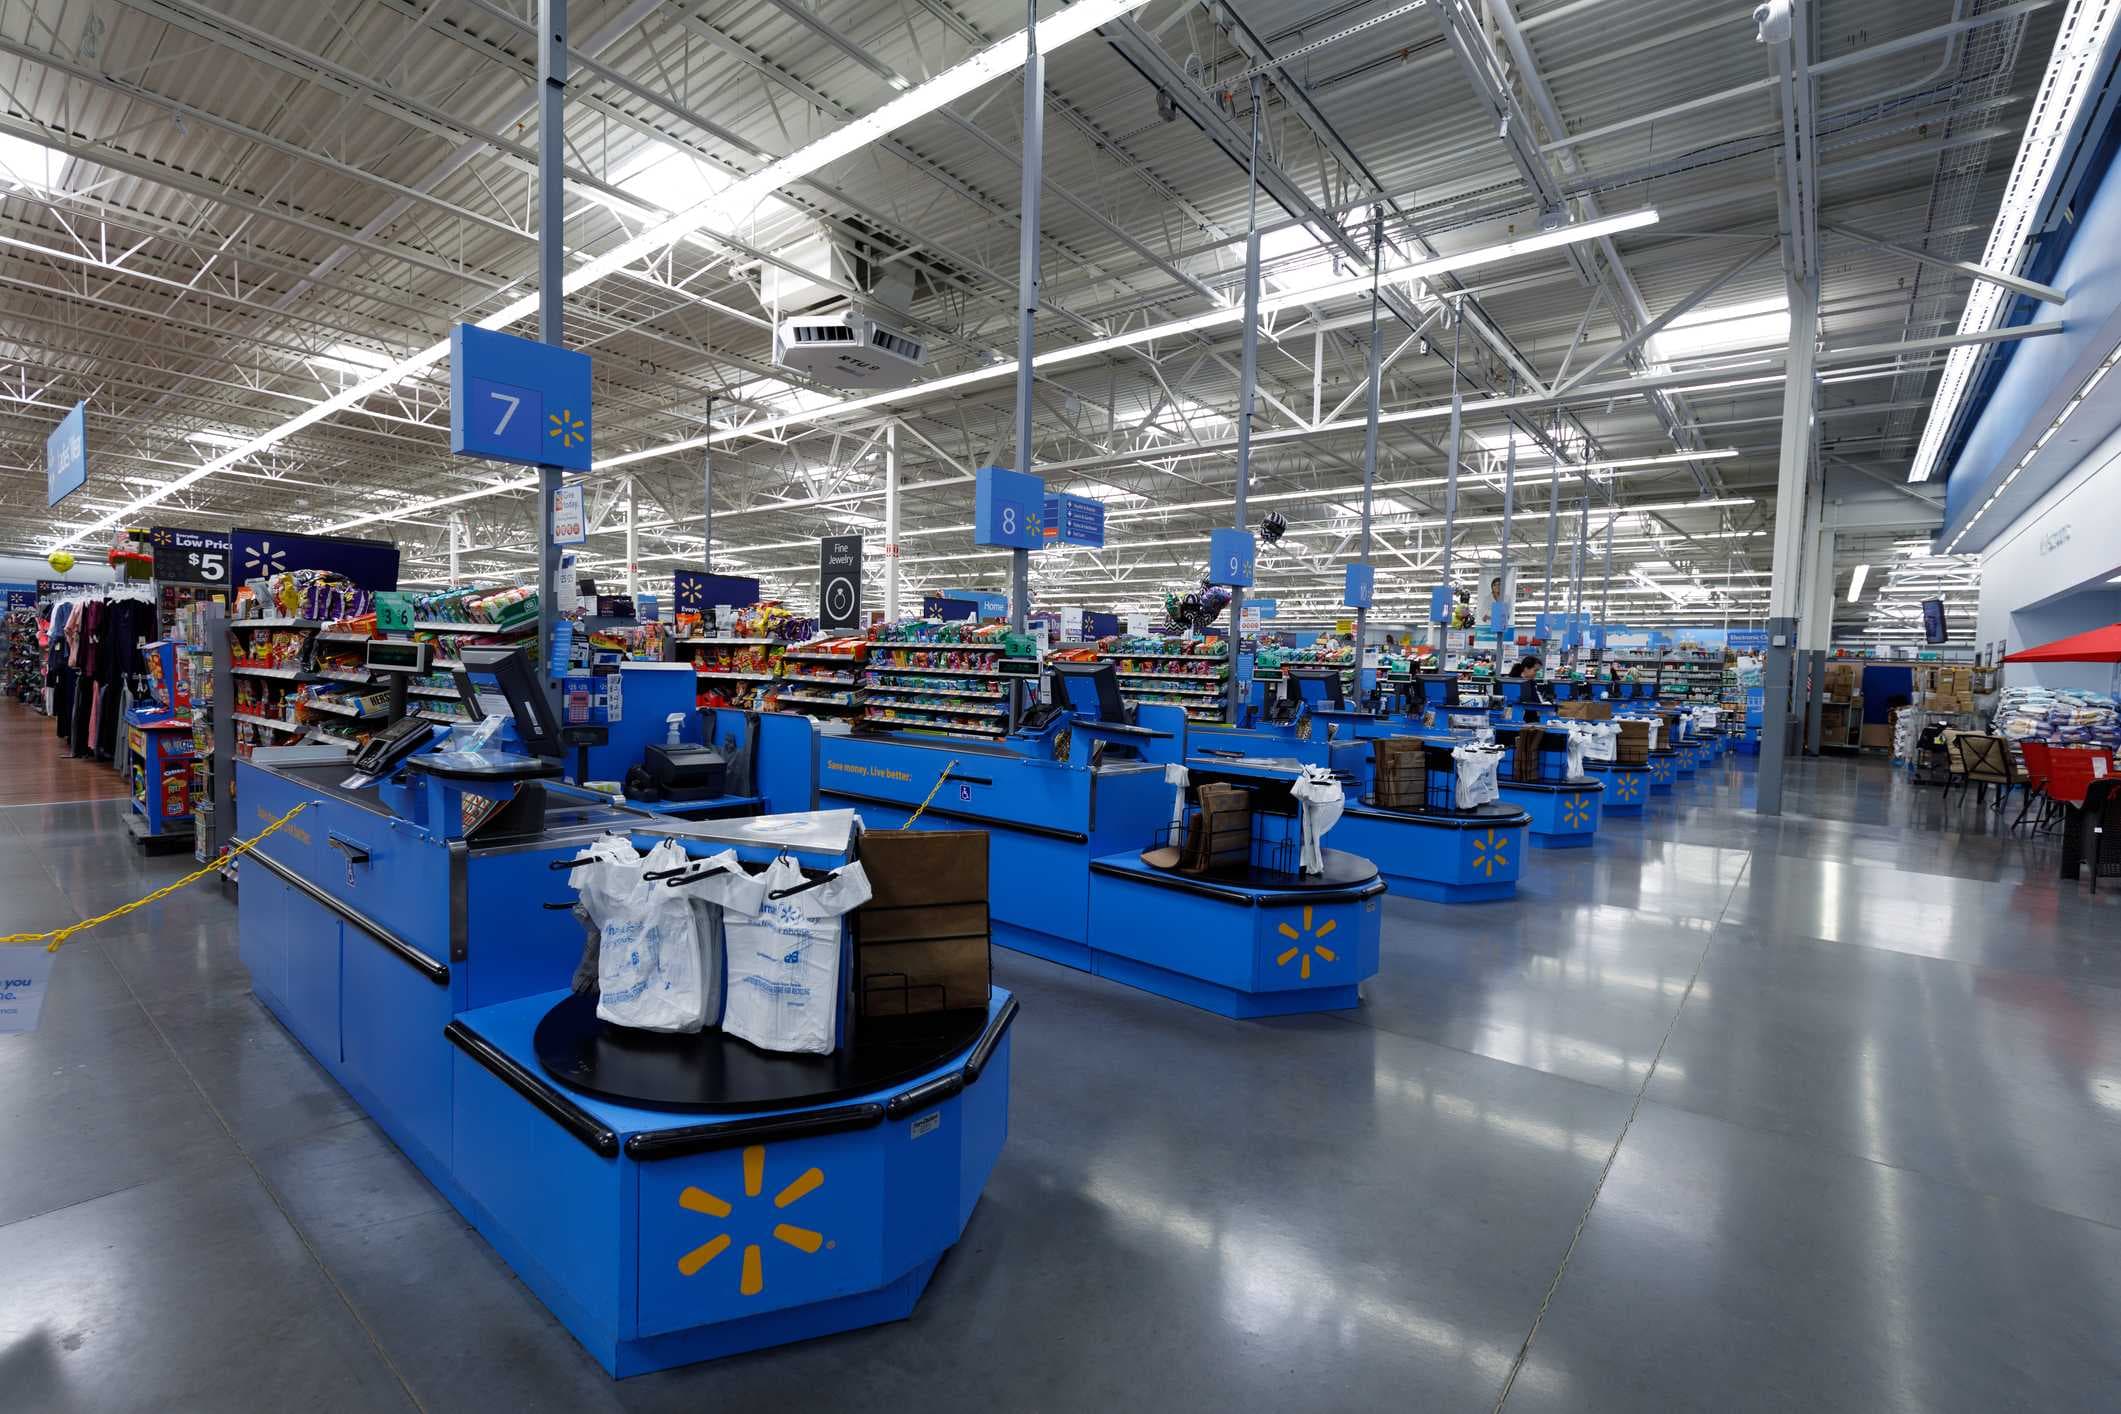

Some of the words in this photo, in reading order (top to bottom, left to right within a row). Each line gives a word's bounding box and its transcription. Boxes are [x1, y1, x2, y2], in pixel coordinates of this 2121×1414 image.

[490, 391, 521, 436] 7
[1002, 507, 1017, 535] 8
[176, 537, 204, 548] Low
[834, 543, 849, 553] Fine
[188, 552, 225, 580] $5
[828, 553, 854, 567] Jewelry
[1230, 556, 1238, 577] 9
[984, 600, 1004, 611] Home
[827, 760, 843, 770] Save
[843, 763, 869, 776] money.
[870, 766, 886, 778] Live
[886, 768, 912, 782] better.
[5, 979, 32, 990] you
